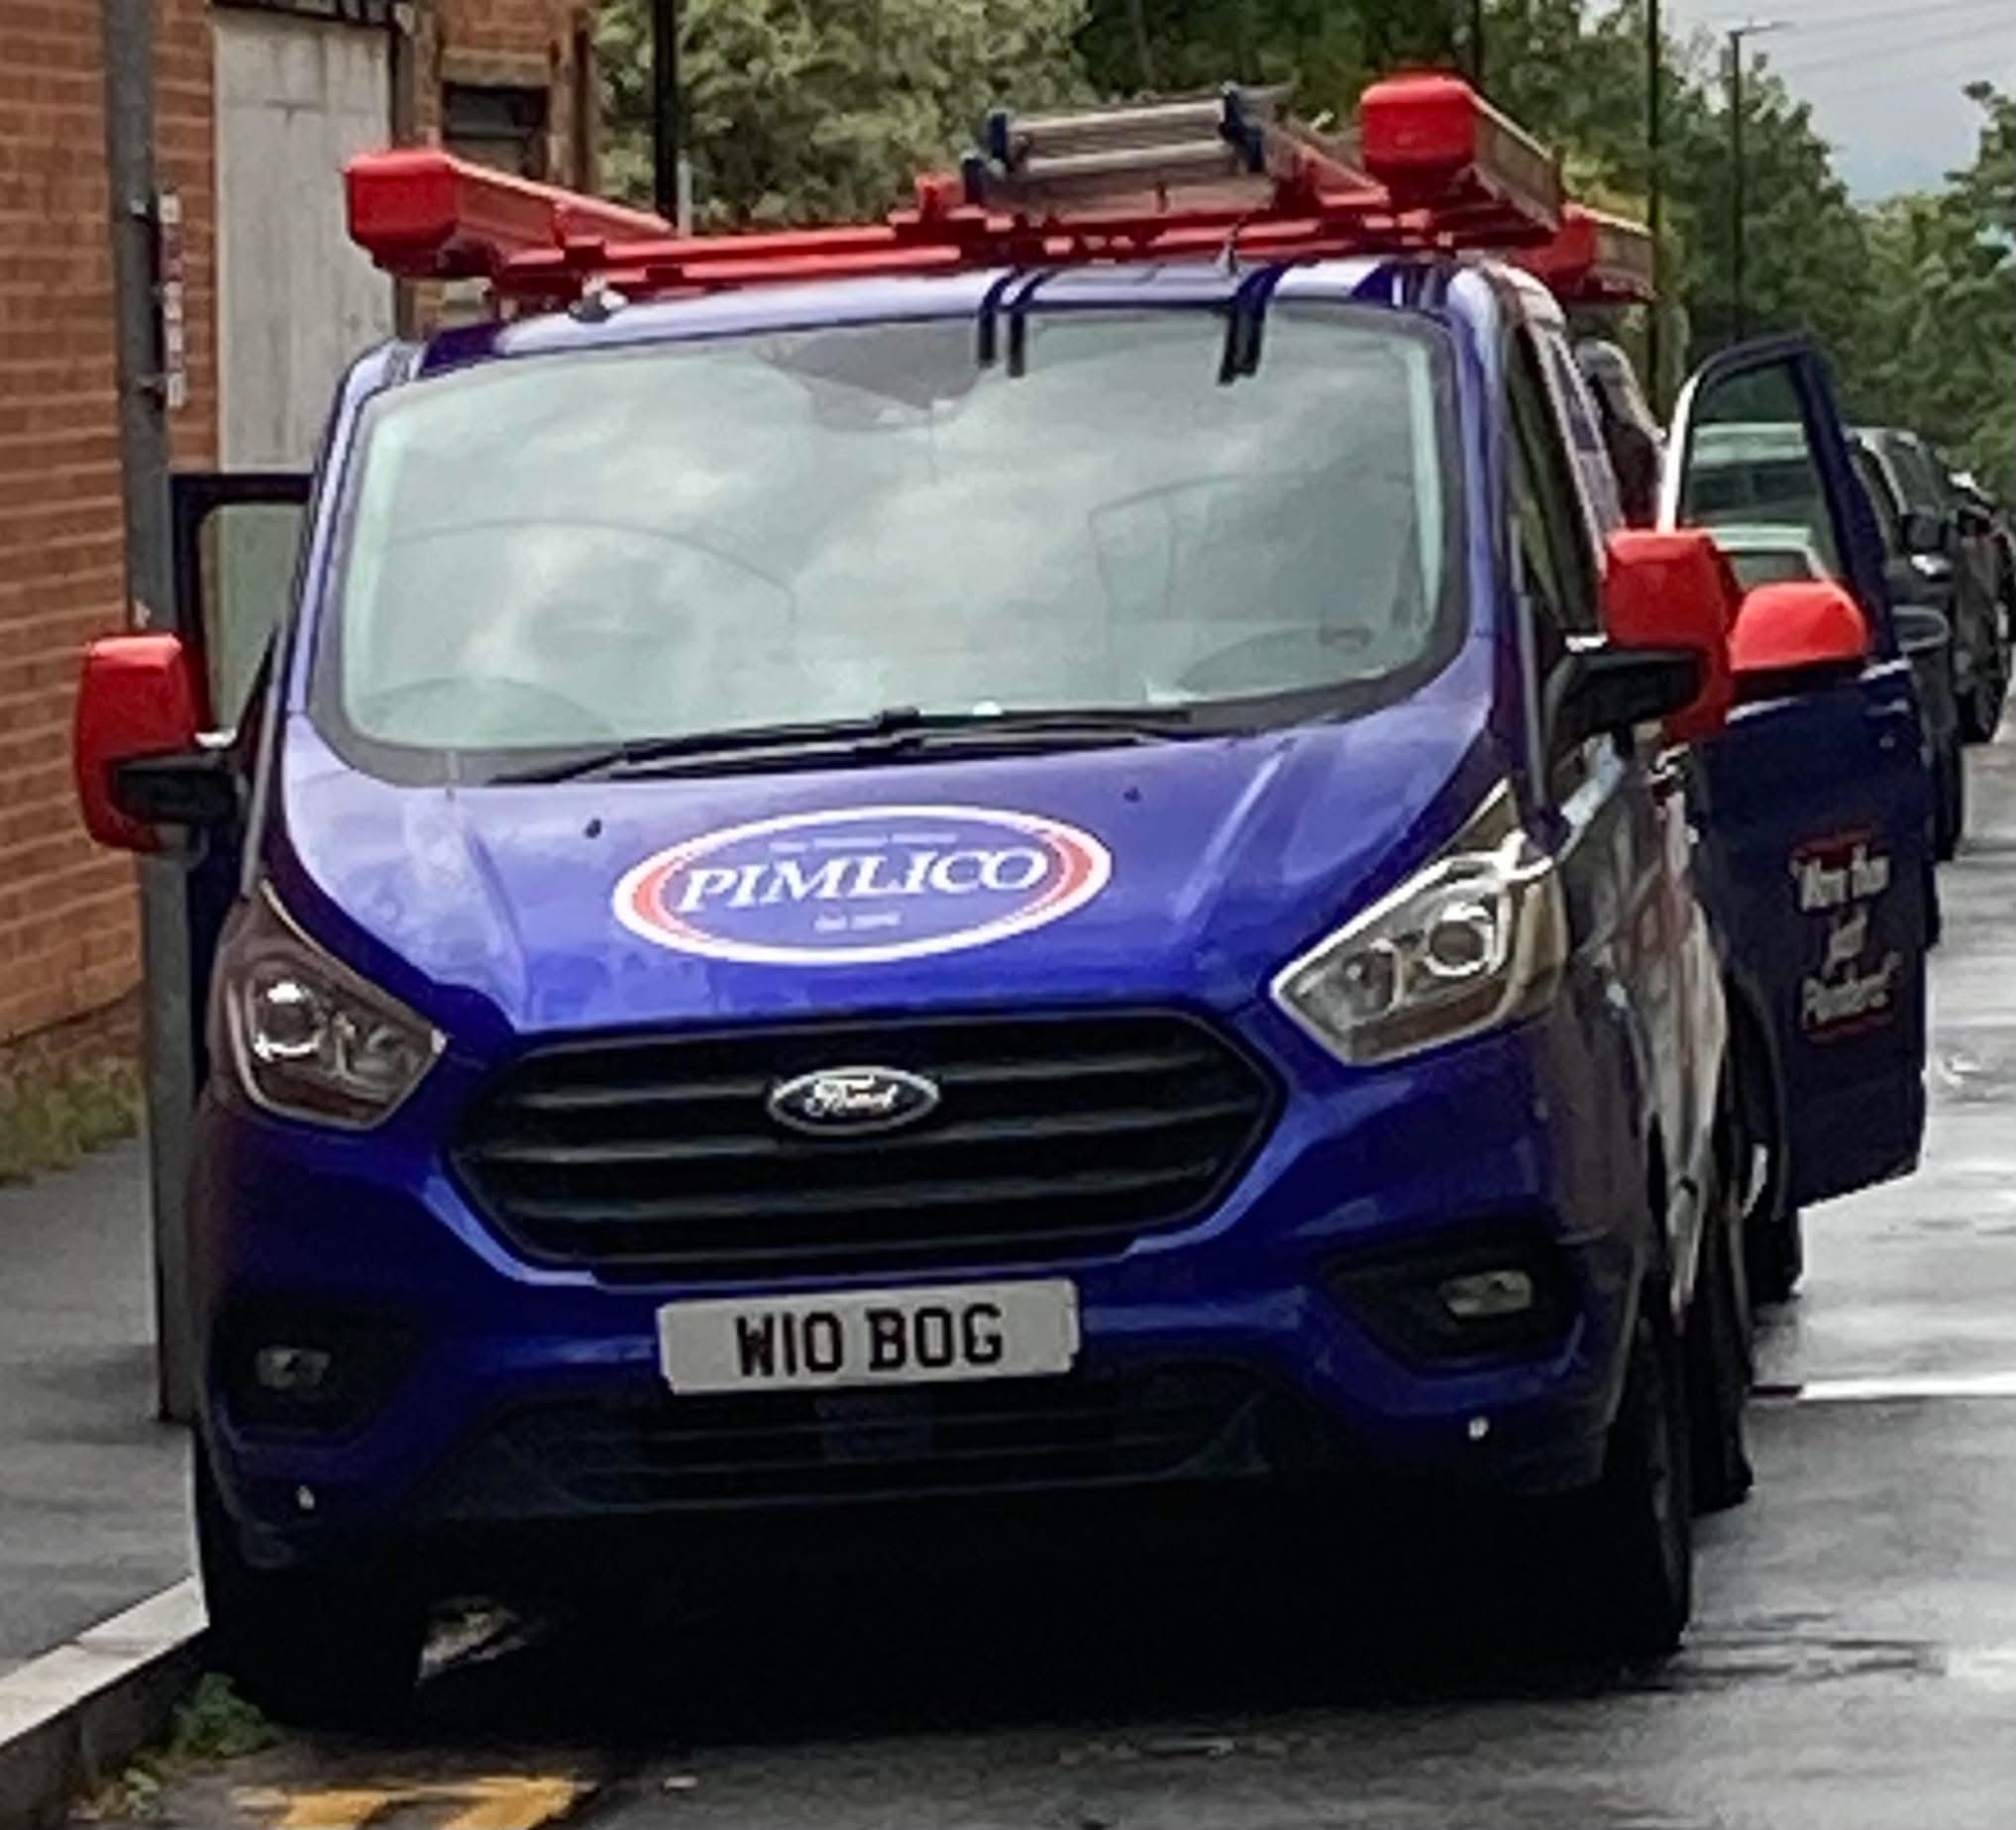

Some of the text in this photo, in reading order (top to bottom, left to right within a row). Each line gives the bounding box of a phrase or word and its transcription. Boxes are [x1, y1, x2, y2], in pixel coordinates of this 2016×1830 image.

[676, 847, 1048, 913] PIMLICO
[803, 1075, 898, 1117] Ford
[865, 1303, 1004, 1373] BOG
